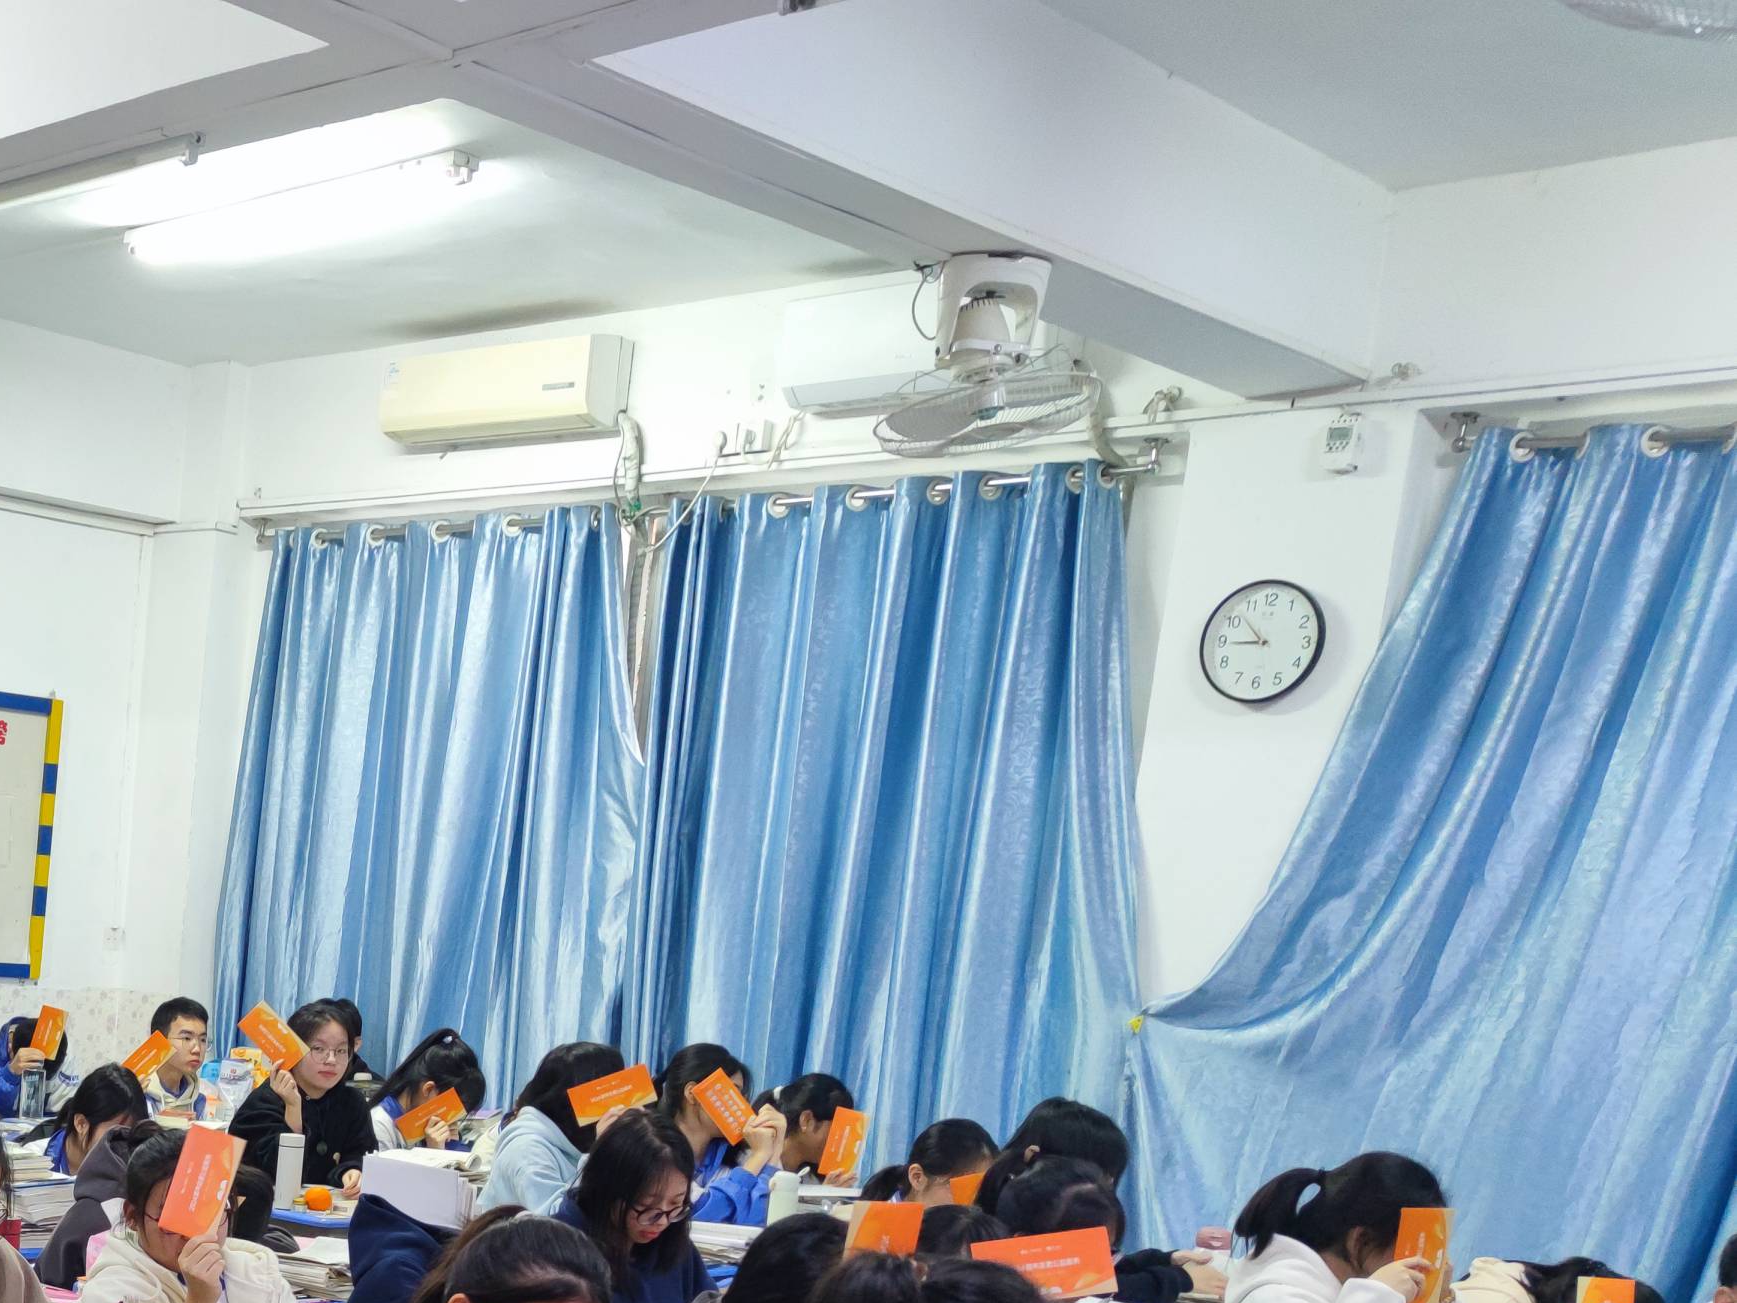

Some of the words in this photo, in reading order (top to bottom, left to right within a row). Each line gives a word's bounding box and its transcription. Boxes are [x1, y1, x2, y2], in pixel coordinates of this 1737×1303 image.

[1246, 600, 1258, 612] 11
[1264, 593, 1279, 607] 12
[1289, 599, 1295, 612] 1
[1227, 615, 1241, 629] 10
[1298, 614, 1310, 629] 2
[1218, 634, 1227, 648] 9
[1301, 635, 1312, 649] 3
[1219, 655, 1229, 669] 8
[1292, 655, 1302, 669] 4
[1234, 671, 1244, 684] 7
[1251, 675, 1261, 689] 6
[1272, 671, 1283, 685] 5
